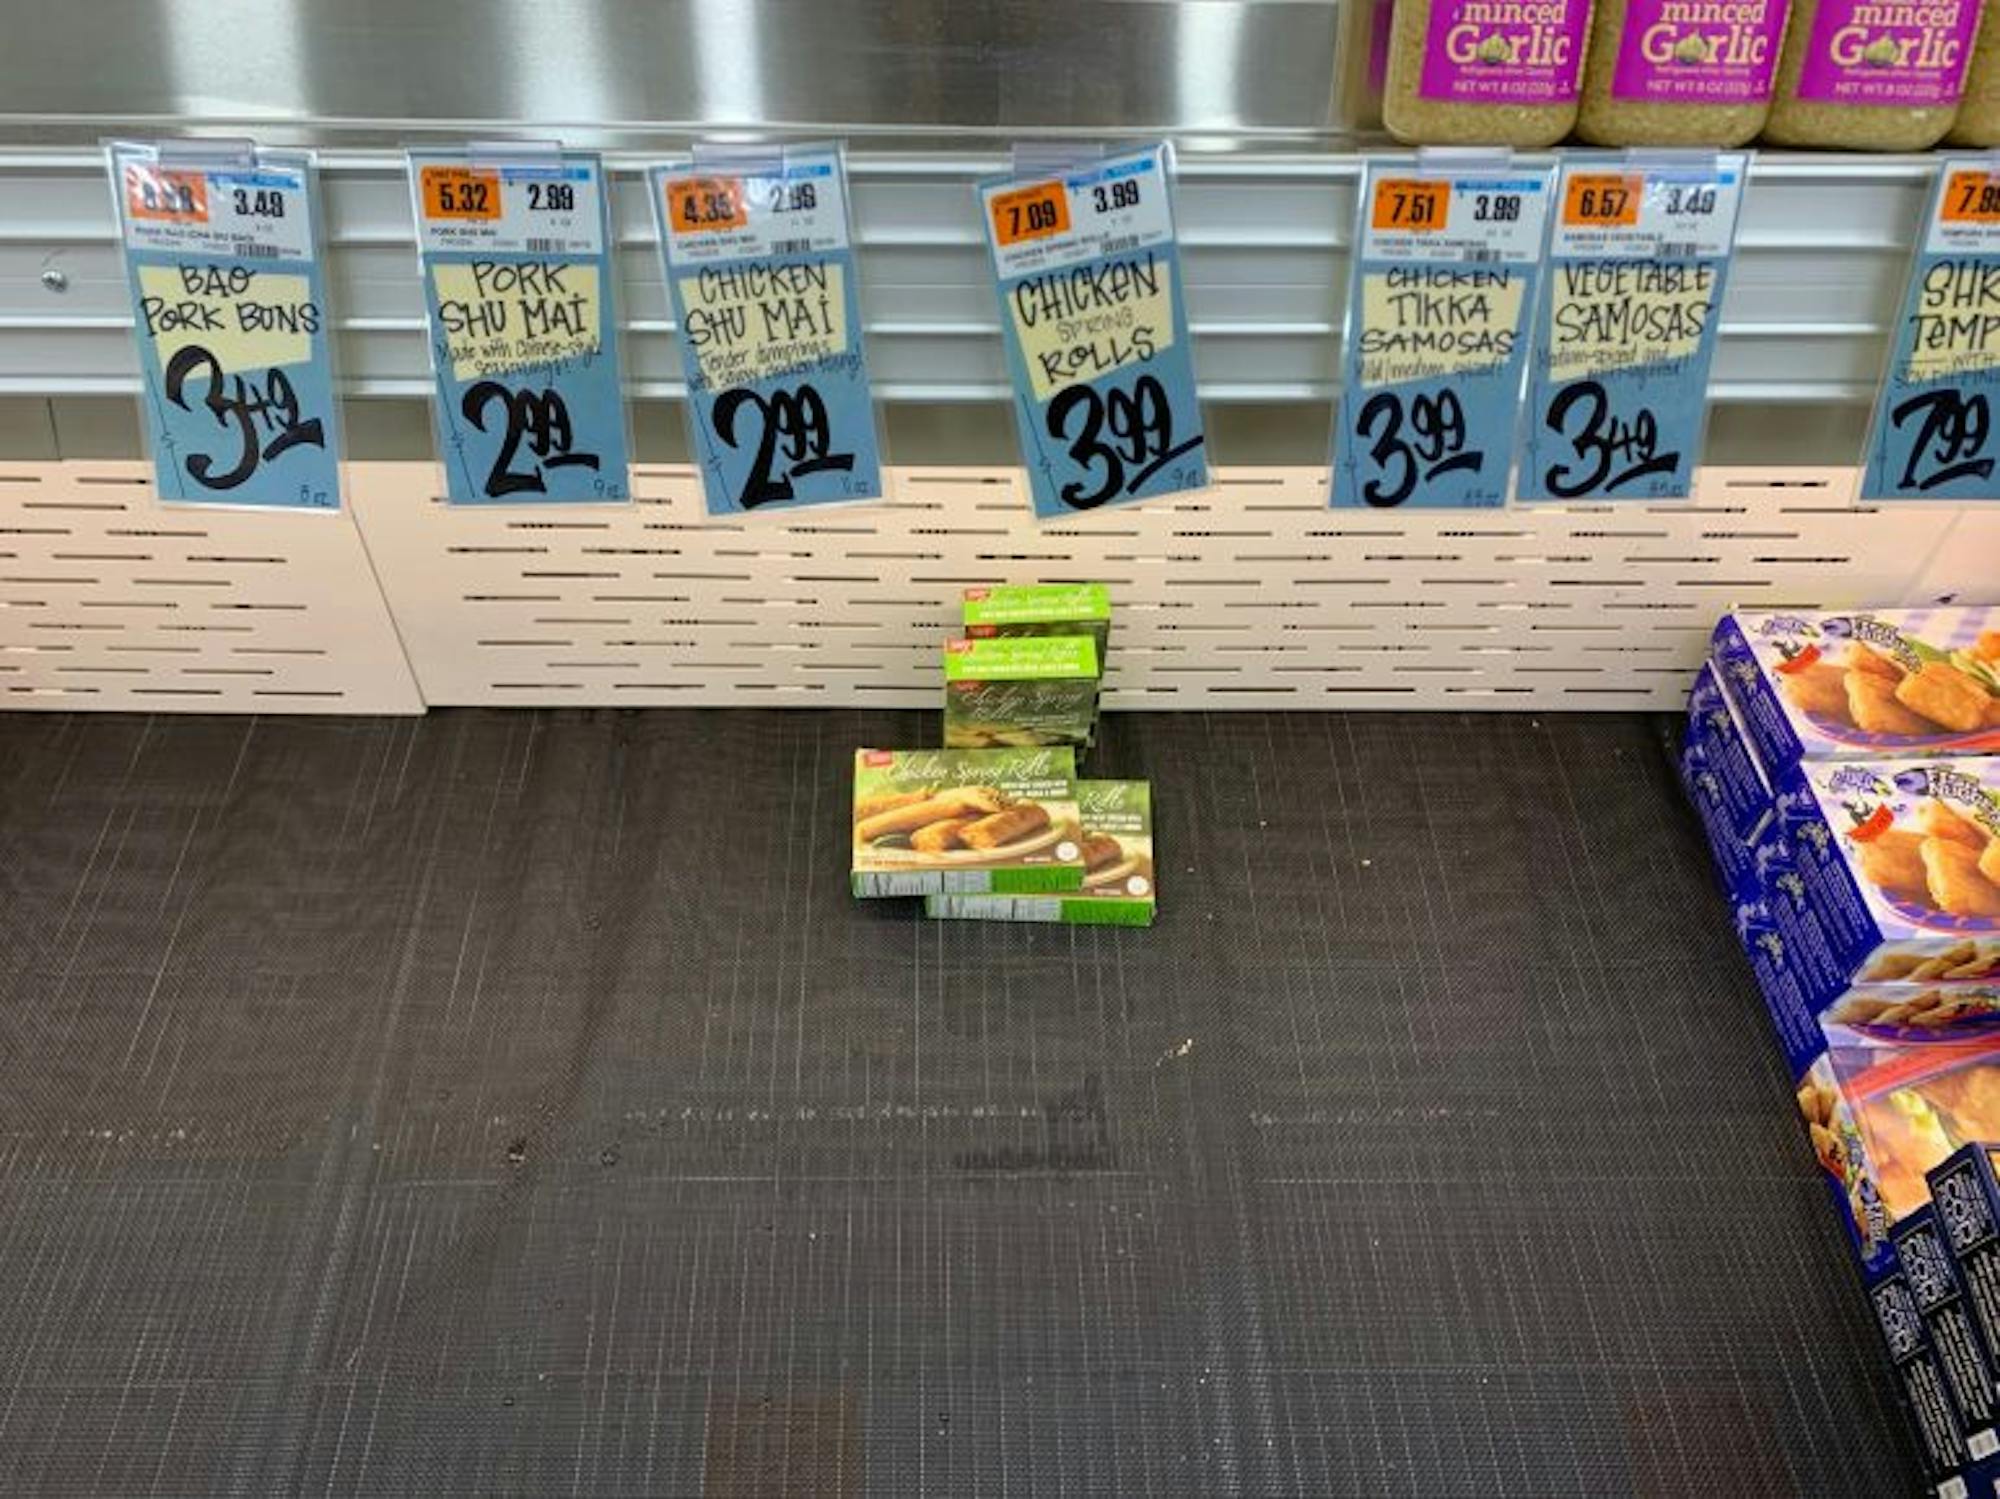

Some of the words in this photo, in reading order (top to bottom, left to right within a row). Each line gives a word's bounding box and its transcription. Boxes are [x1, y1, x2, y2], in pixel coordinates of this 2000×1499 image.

[1463, 0, 1567, 24] minced
[1660, 0, 1766, 24] minced
[1852, 1, 1961, 26] minced
[233, 188, 284, 218] 3.49
[439, 184, 488, 212] 5.32
[528, 184, 573, 211] 2.99
[684, 194, 734, 223] 4.35
[1093, 179, 1140, 213] 3.99
[1392, 194, 1434, 222] 7.51
[1474, 195, 1521, 221] 3.99
[1580, 189, 1628, 218] 6.57
[1008, 199, 1057, 236] 7.09
[180, 263, 257, 298] BAO
[472, 261, 569, 298] PORK
[699, 261, 828, 304] CHICKEN
[1387, 266, 1510, 290] CHICKEN
[1564, 259, 1712, 296] VEGETABLE
[141, 297, 225, 336] PORK
[236, 303, 320, 335] BUNS
[439, 300, 506, 338] SHU
[685, 305, 746, 346] SHU
[1056, 308, 1135, 343] SPRING
[1387, 292, 1494, 327] TIKKA
[1556, 297, 1716, 345] SAMOSAS
[1038, 327, 1156, 385] ROLLS
[1359, 328, 1522, 355] SAMOSAS
